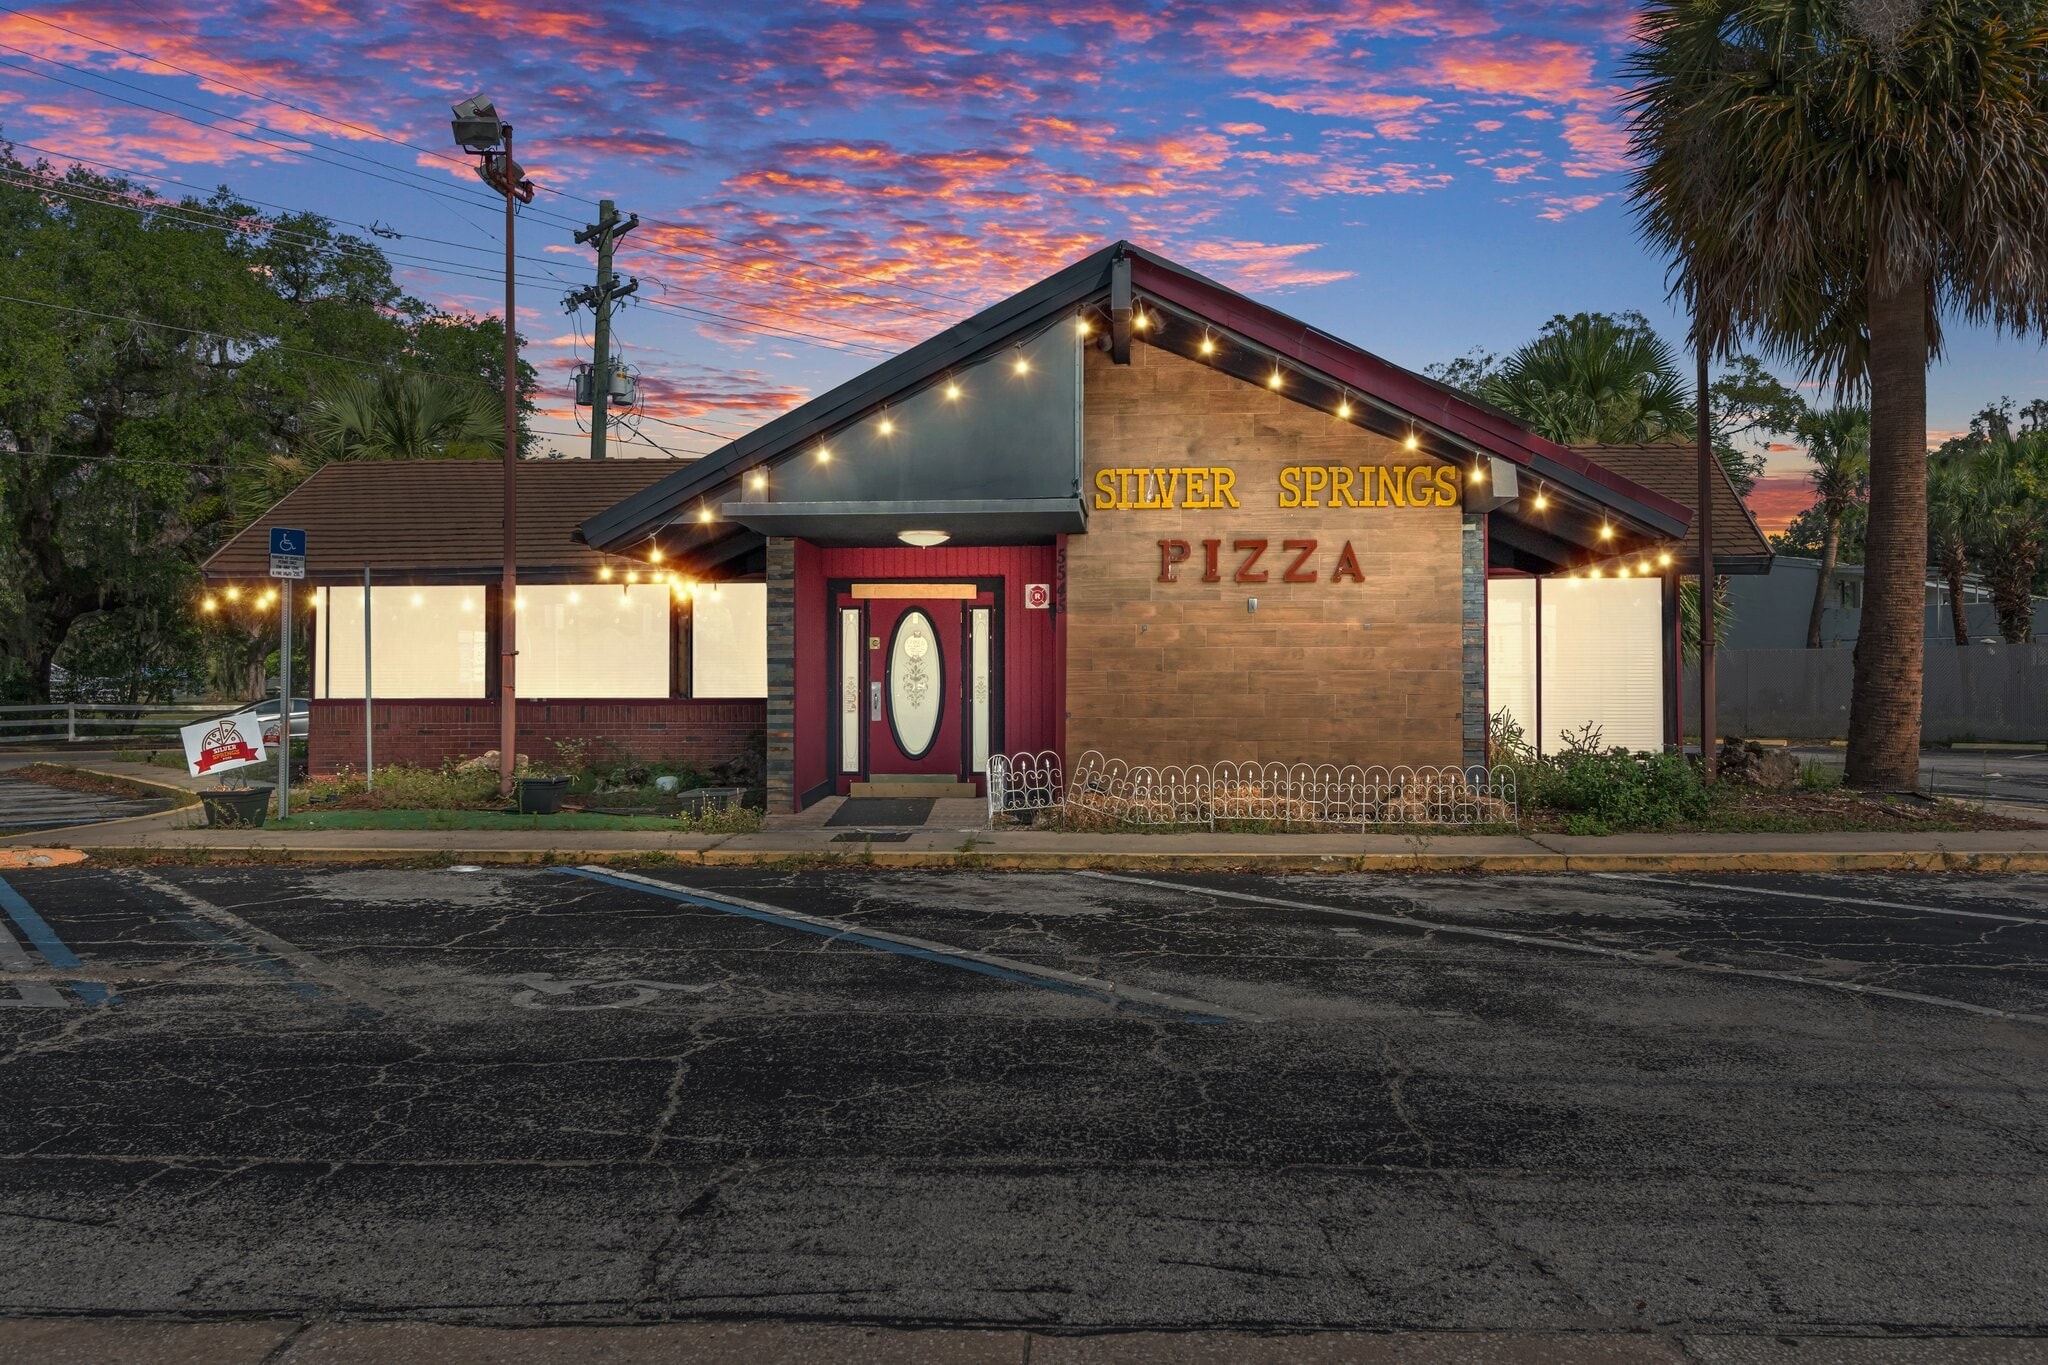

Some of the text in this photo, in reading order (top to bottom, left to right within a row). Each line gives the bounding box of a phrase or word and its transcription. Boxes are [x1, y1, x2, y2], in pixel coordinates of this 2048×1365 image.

[1095, 465, 1457, 509] SILVER SPRINGS
[1157, 539, 1365, 582] PIZZA
[212, 749, 240, 760] SPRINGS
[213, 744, 237, 754] SILVER
